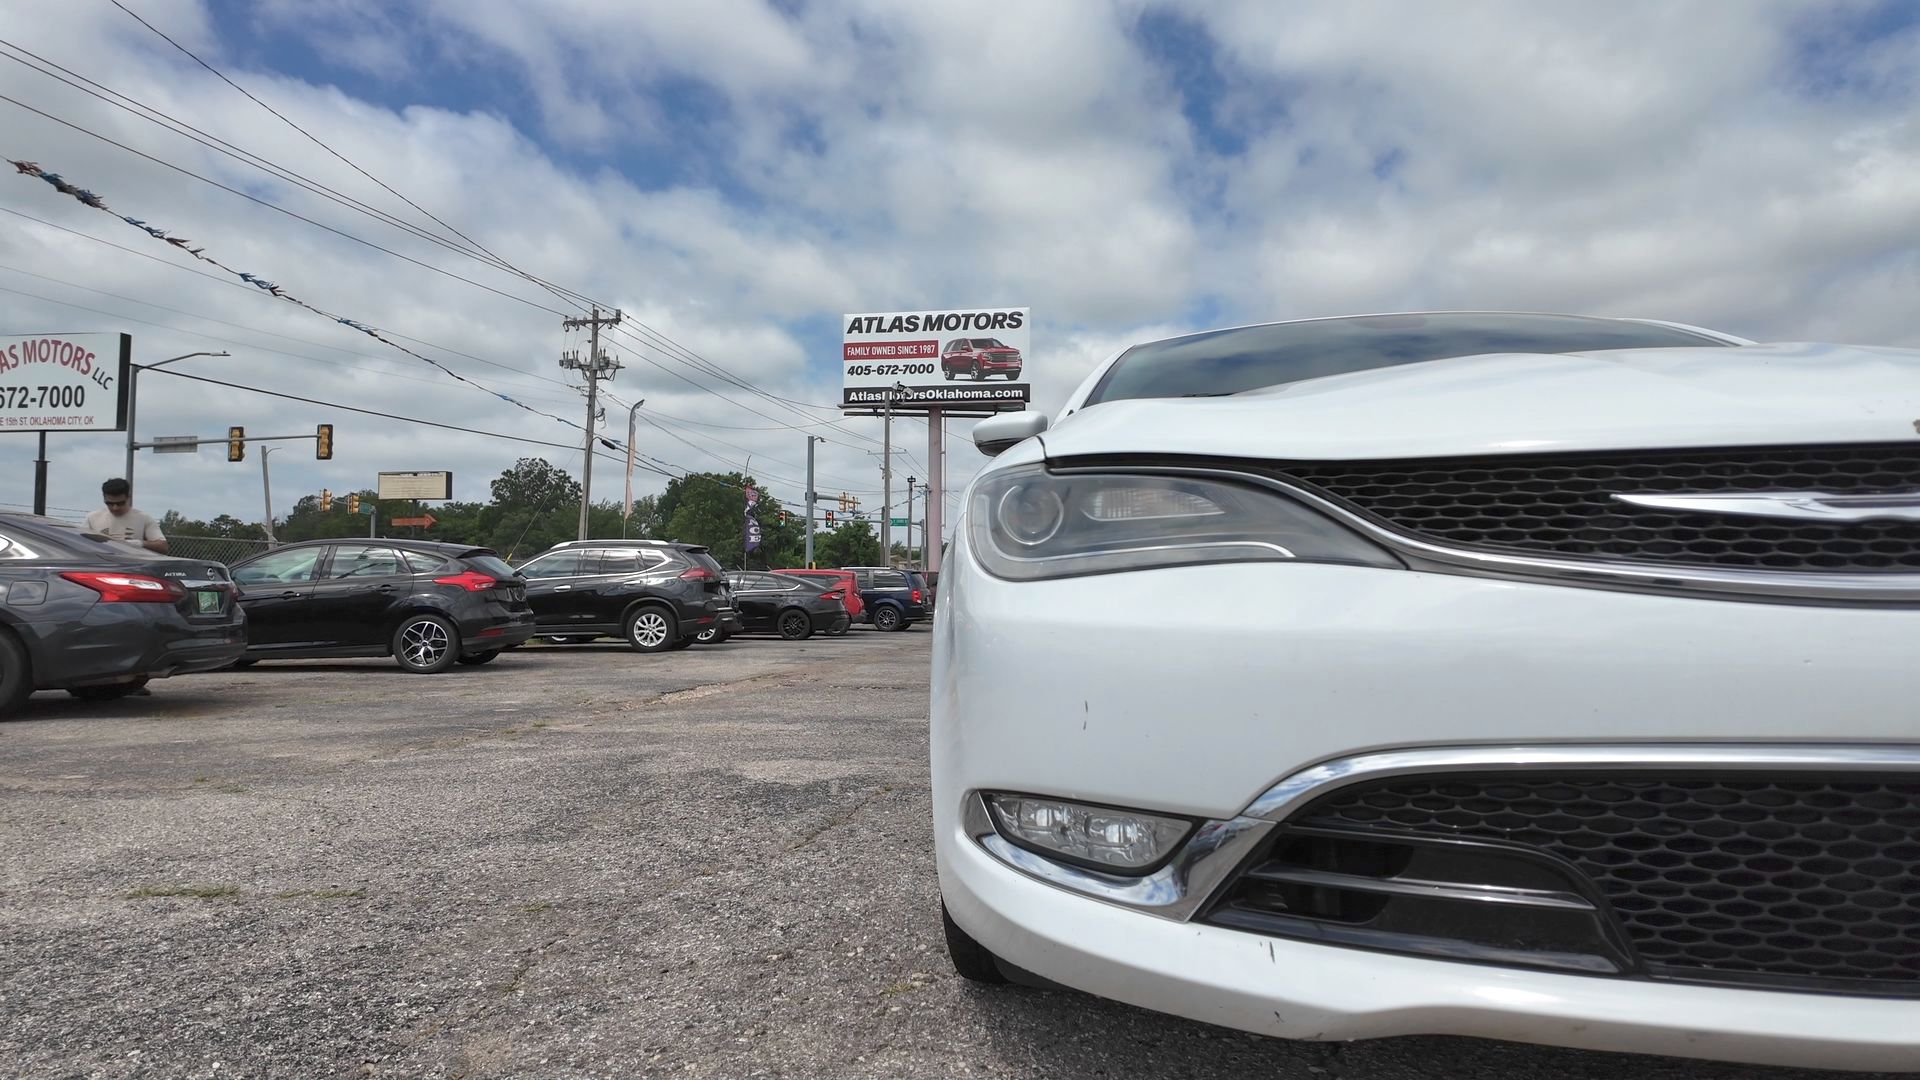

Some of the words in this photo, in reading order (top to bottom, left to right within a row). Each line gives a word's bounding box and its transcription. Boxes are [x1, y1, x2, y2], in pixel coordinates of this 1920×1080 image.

[847, 314, 920, 335] ATLAS
[922, 311, 1024, 332] MOTORS
[847, 347, 870, 357] FAMILY
[872, 346, 896, 356] OWNED
[897, 345, 918, 355] SINCE
[919, 344, 936, 354] 1987
[22, 338, 95, 375] MOTORS
[92, 366, 113, 390] LLC
[847, 363, 935, 376] 405-672-7000
[30, 416, 66, 426] OKLAHOMA
[84, 415, 94, 425] OK
